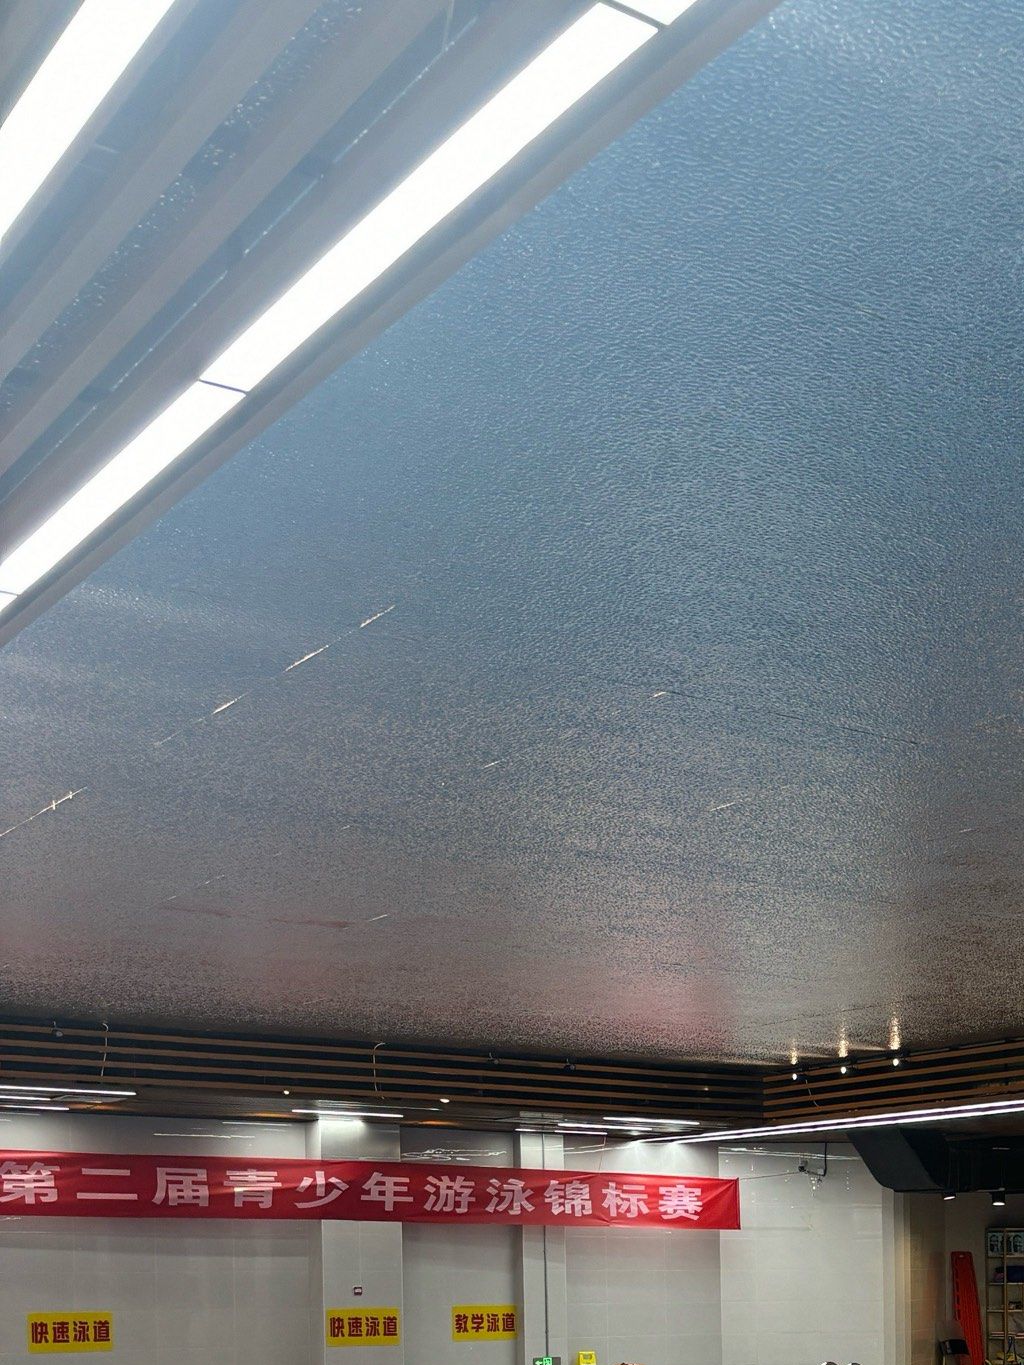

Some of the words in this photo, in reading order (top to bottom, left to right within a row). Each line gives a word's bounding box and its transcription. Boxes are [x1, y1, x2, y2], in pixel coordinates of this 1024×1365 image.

[0, 1161, 704, 1221] 第二届青少年游泳锦标赛
[31, 1320, 110, 1344] 快速泳道
[329, 1316, 398, 1337] 快速泳道
[455, 1312, 515, 1333] 教学泳道
